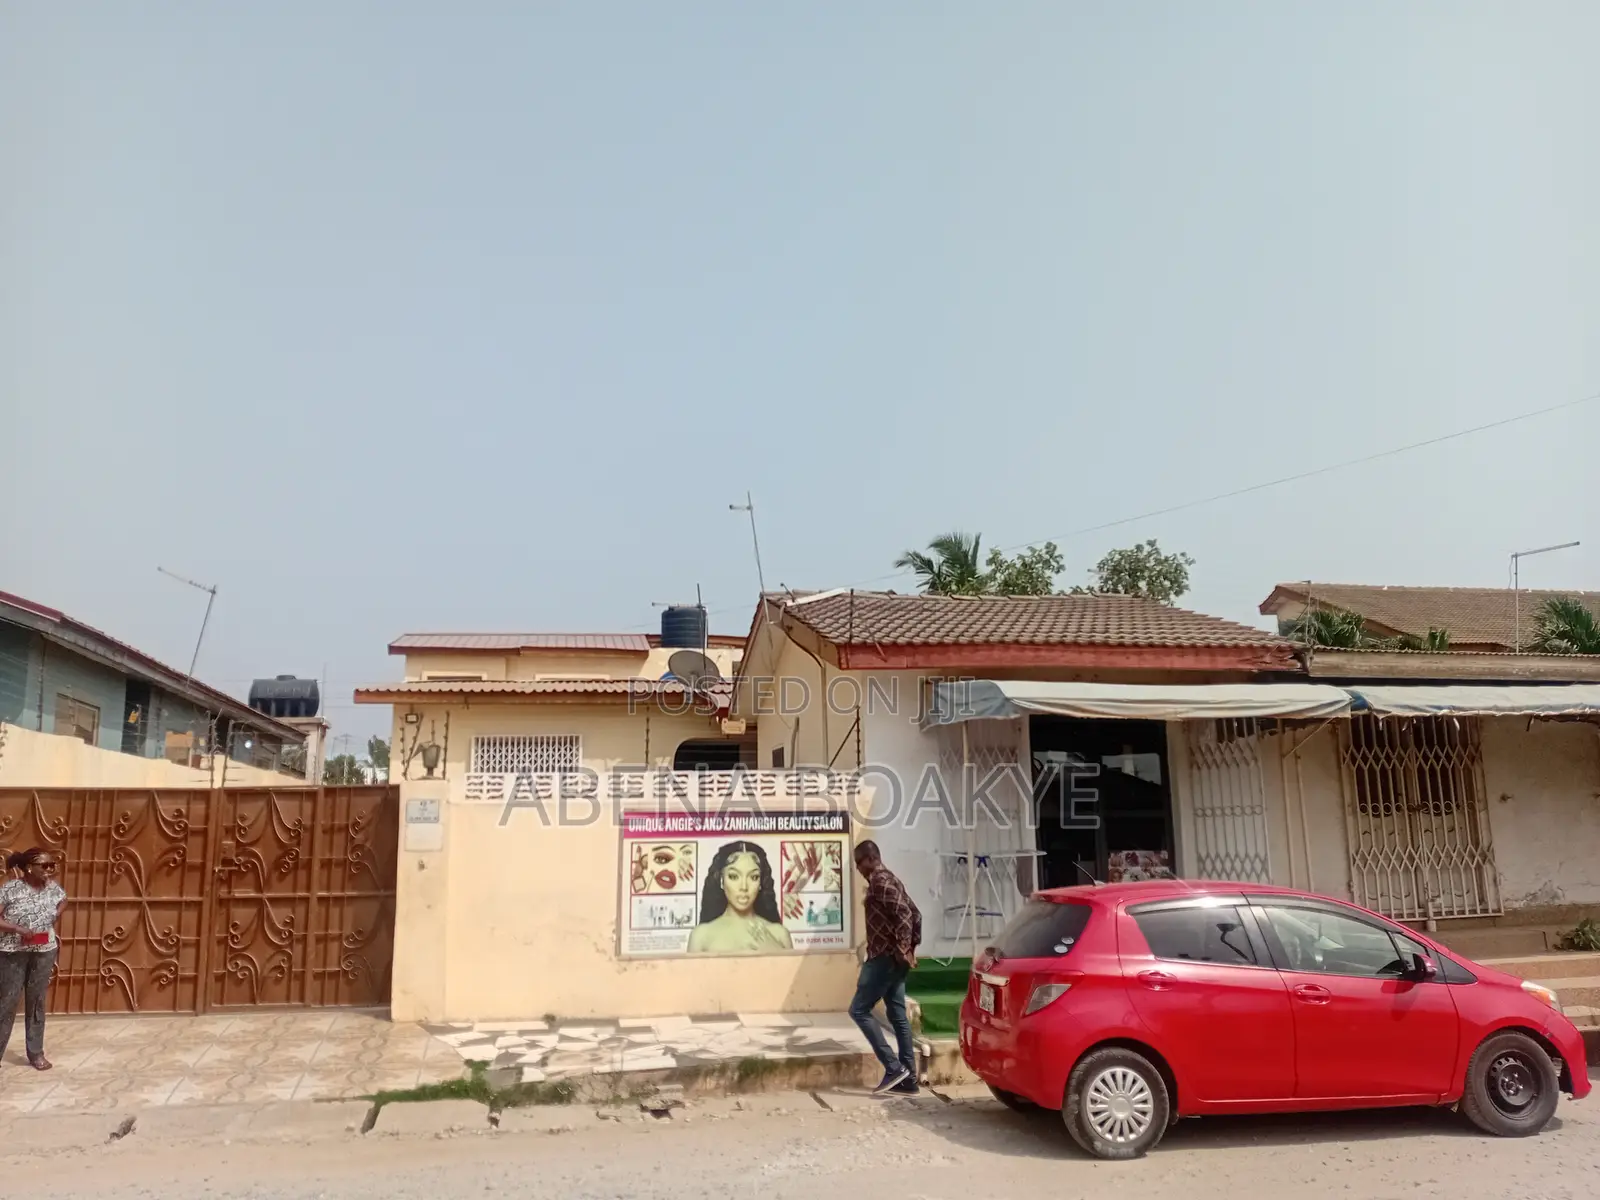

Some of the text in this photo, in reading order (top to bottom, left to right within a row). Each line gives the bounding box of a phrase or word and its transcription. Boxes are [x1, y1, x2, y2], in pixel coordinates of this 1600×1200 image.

[628, 817, 665, 832] UNIQUE
[665, 817, 702, 831] ANGIE'S
[702, 817, 723, 831] AND
[777, 816, 813, 831] BEAUTY
[813, 816, 843, 831] SALON
